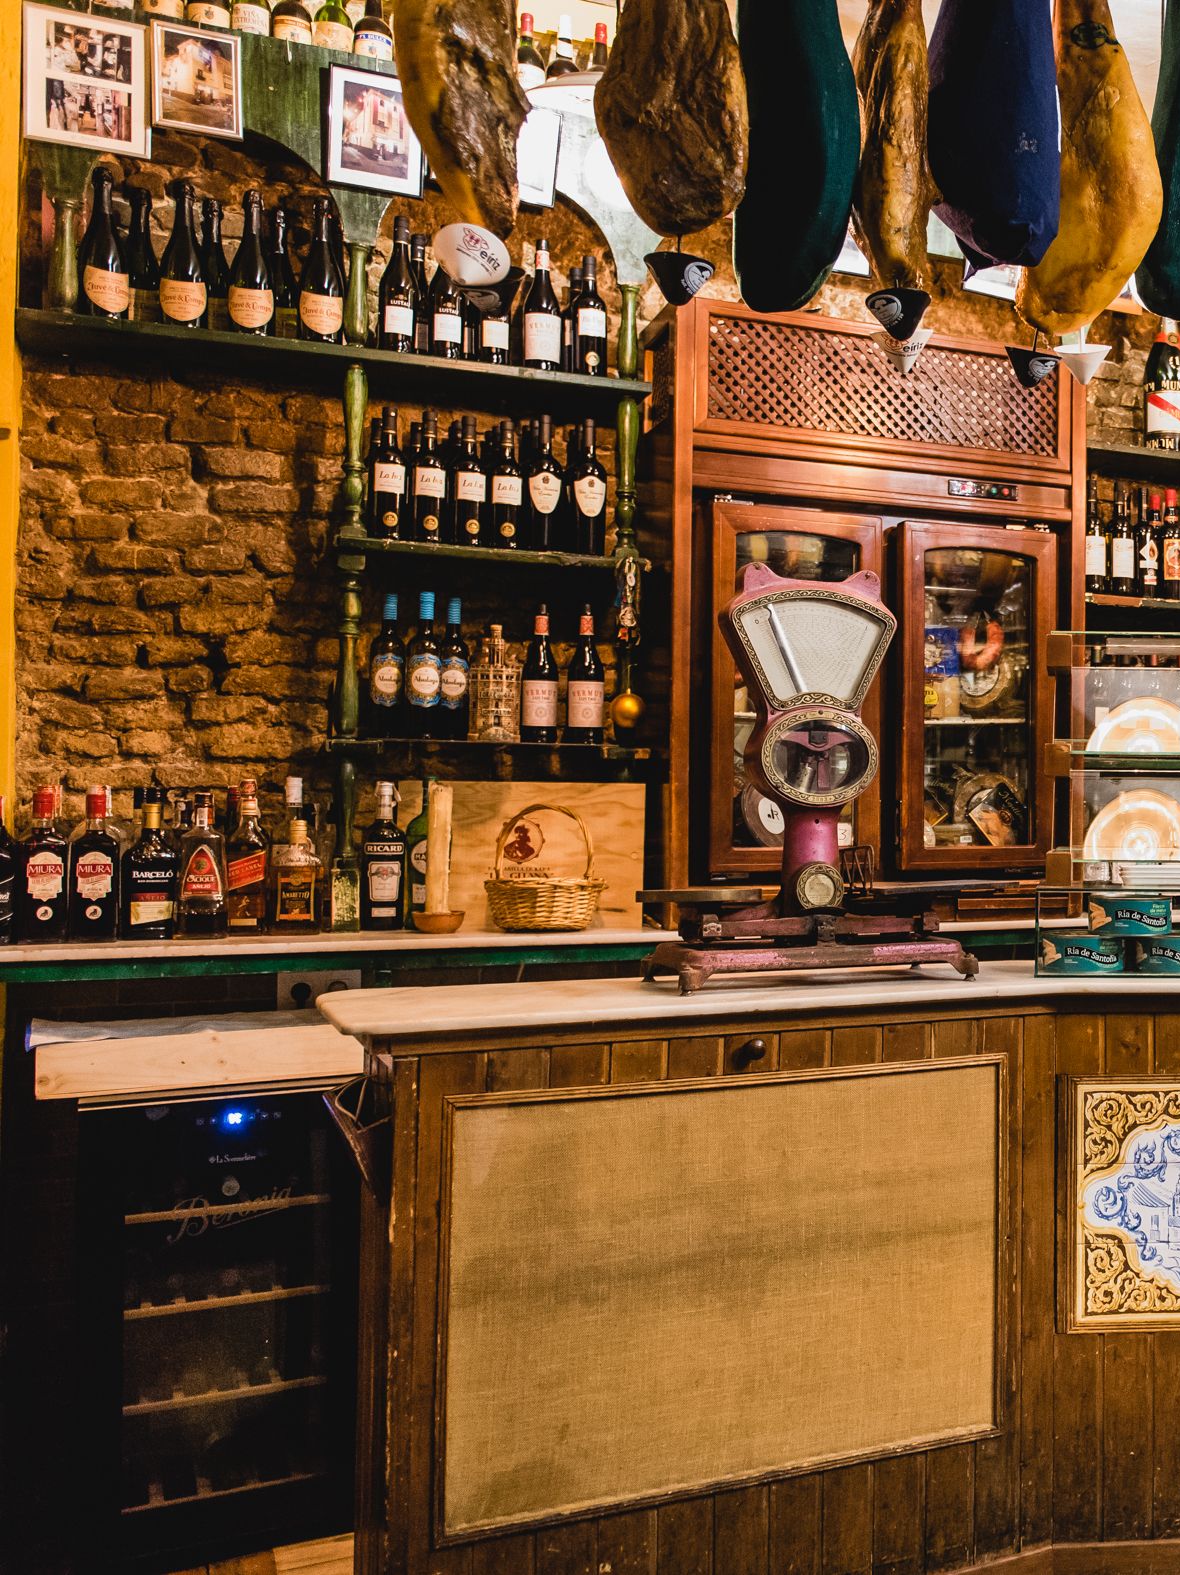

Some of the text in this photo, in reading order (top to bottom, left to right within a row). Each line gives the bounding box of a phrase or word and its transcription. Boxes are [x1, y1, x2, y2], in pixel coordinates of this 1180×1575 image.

[28, 865, 62, 874] MIURA
[78, 865, 111, 874] MIURA
[132, 869, 173, 879] BARCELÓ
[1117, 910, 1166, 926] Ría de Santoña
[1067, 947, 1117, 963] Ría de Santoña
[1152, 947, 1163, 955] Ría
[1164, 949, 1173, 957] de
